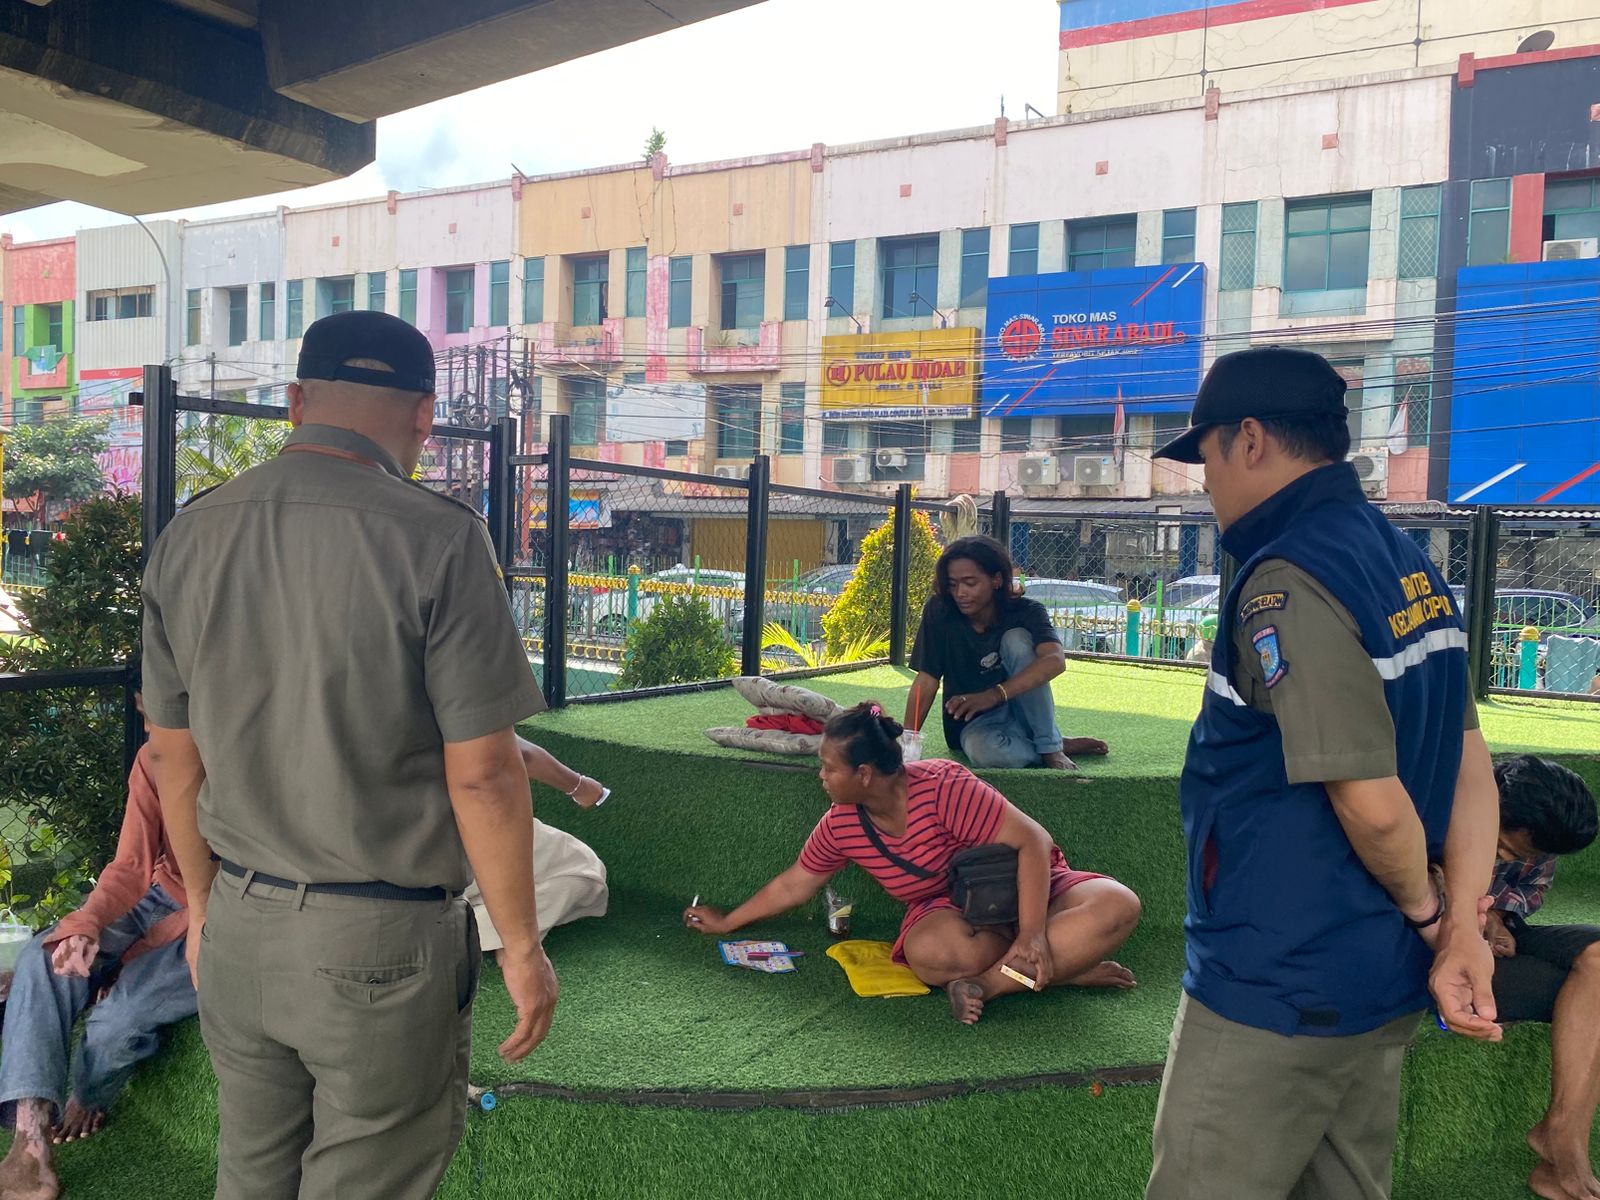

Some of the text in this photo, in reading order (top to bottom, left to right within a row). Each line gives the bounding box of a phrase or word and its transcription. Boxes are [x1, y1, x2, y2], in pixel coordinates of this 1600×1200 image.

[1052, 312, 1117, 324] TOKO MAS
[1052, 321, 1175, 349] SINAR ABADI
[854, 362, 907, 381] PULAU
[911, 360, 967, 380] INDAH
